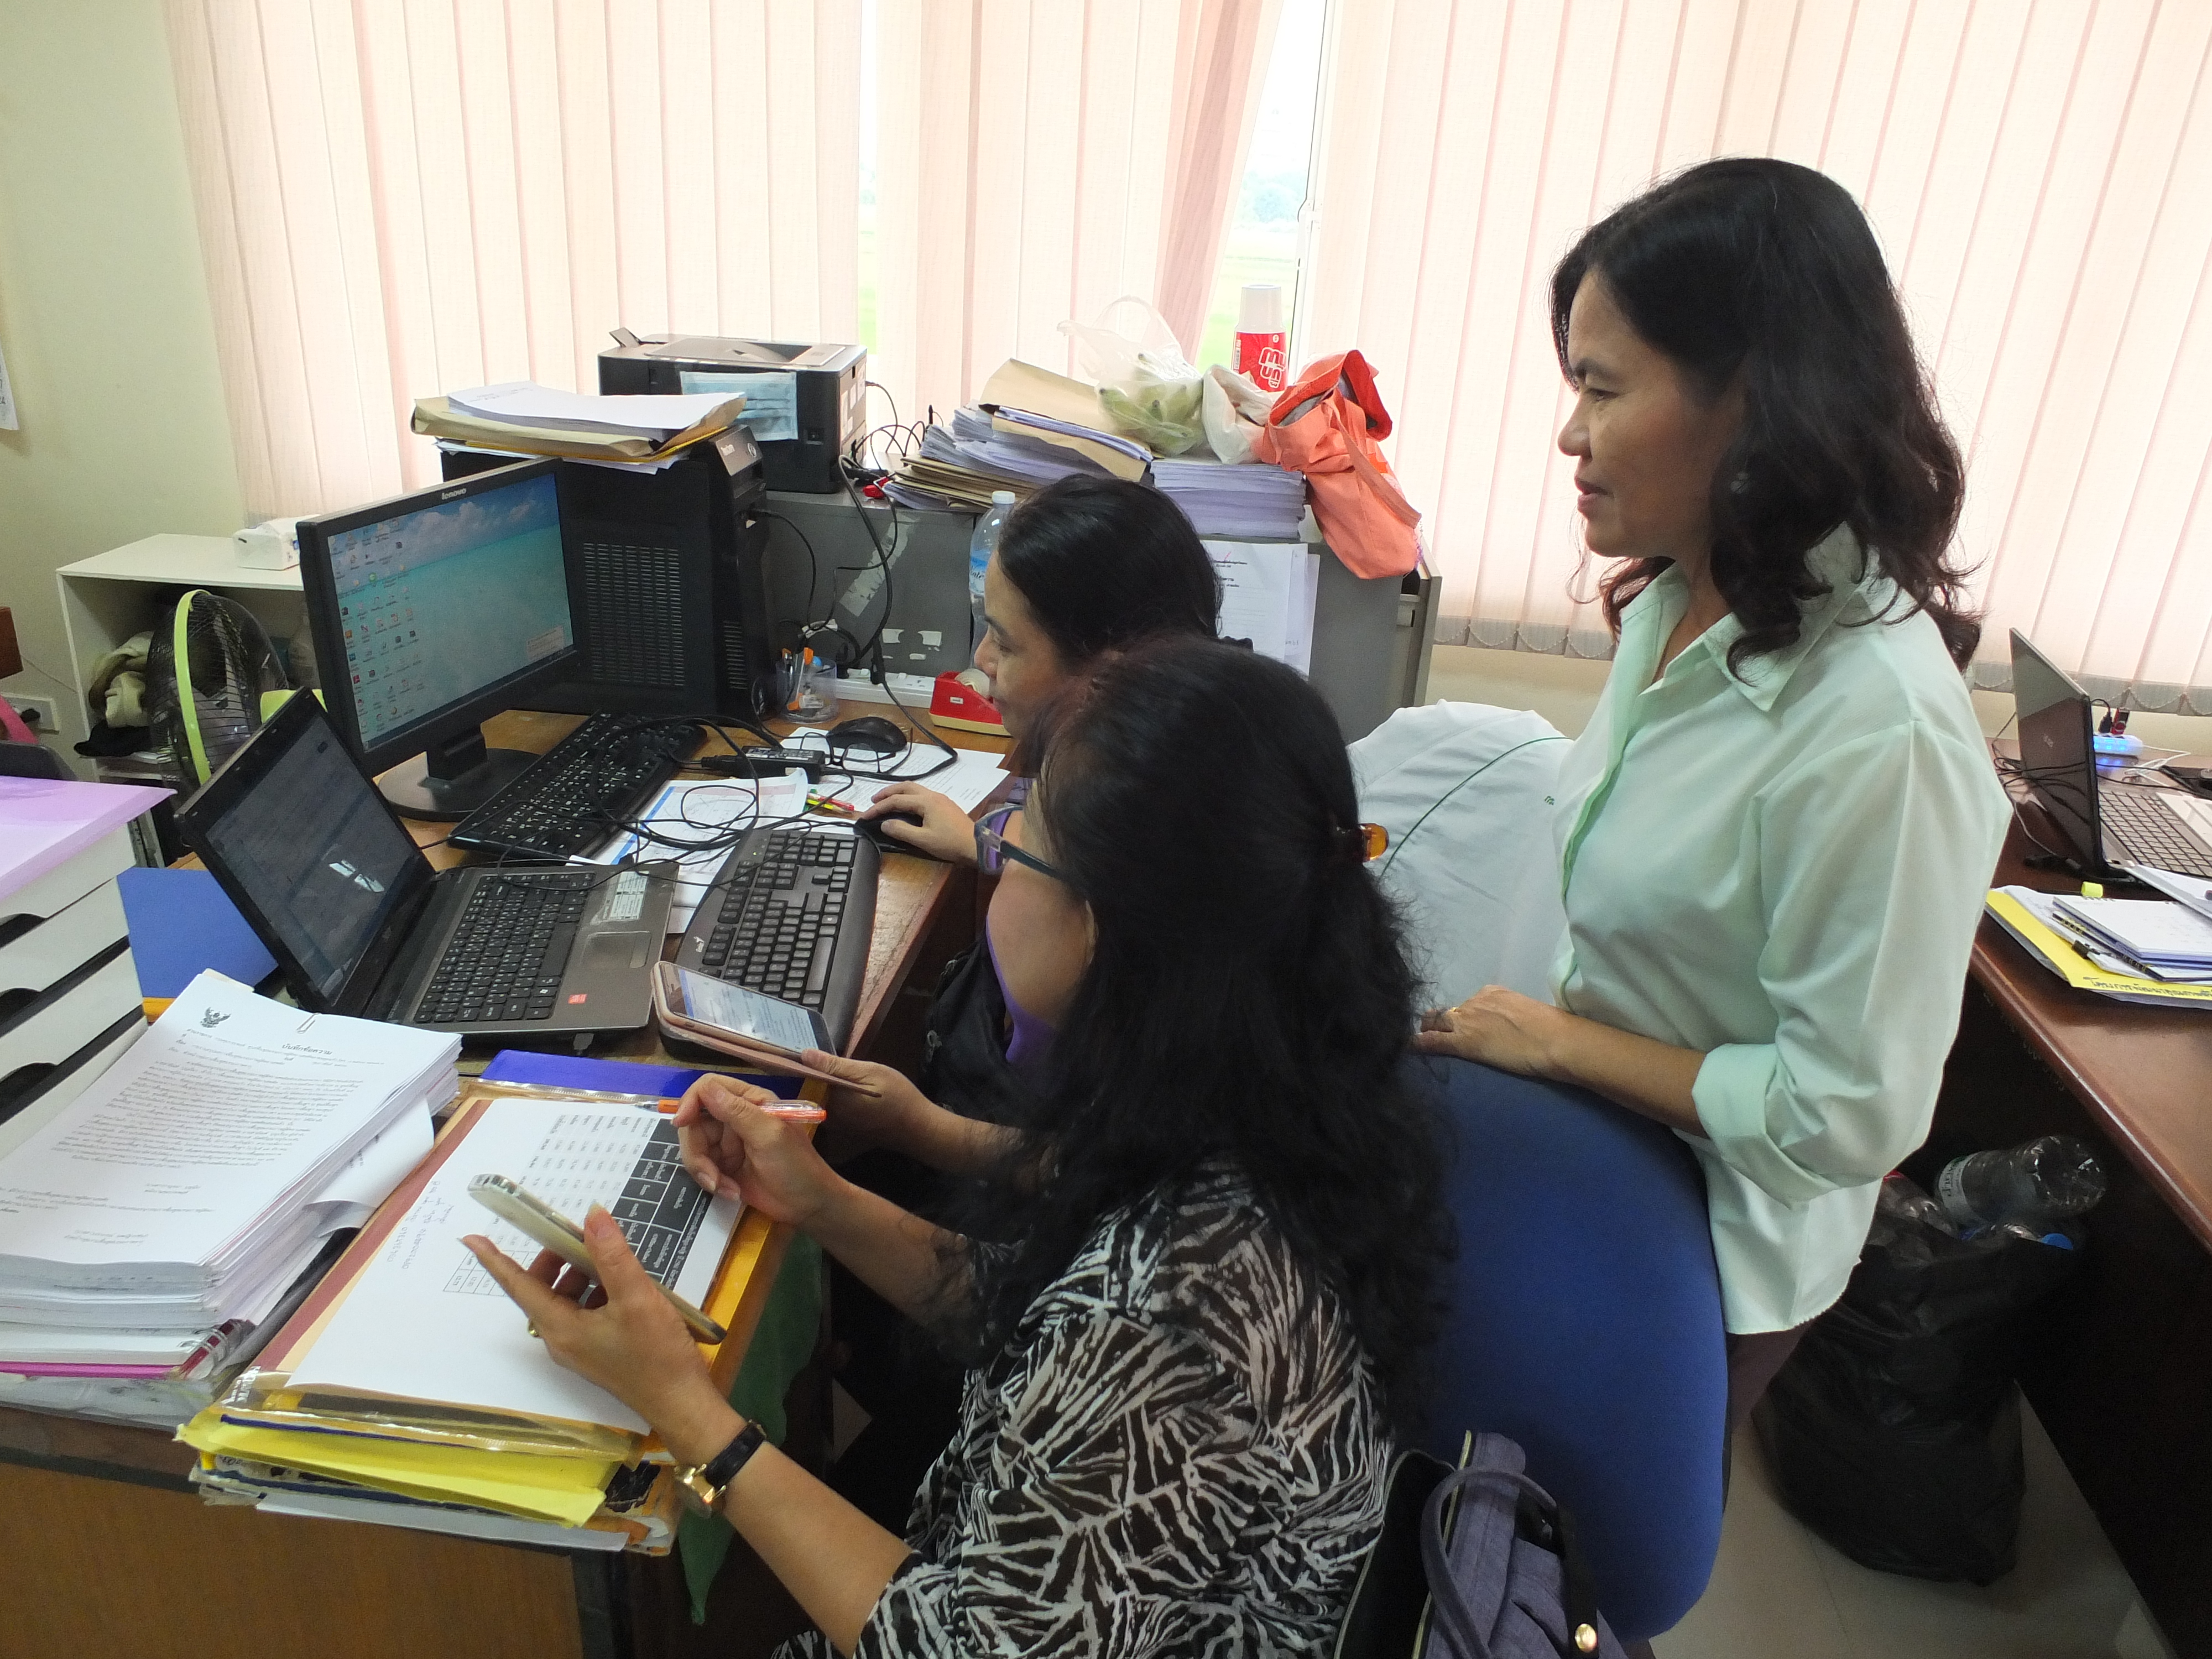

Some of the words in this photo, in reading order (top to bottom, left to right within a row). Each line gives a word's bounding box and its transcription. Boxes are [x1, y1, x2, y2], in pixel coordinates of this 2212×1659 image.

[442, 488, 467, 500] lenovo
[281, 1042, 333, 1055] บันทึกข้อความ
